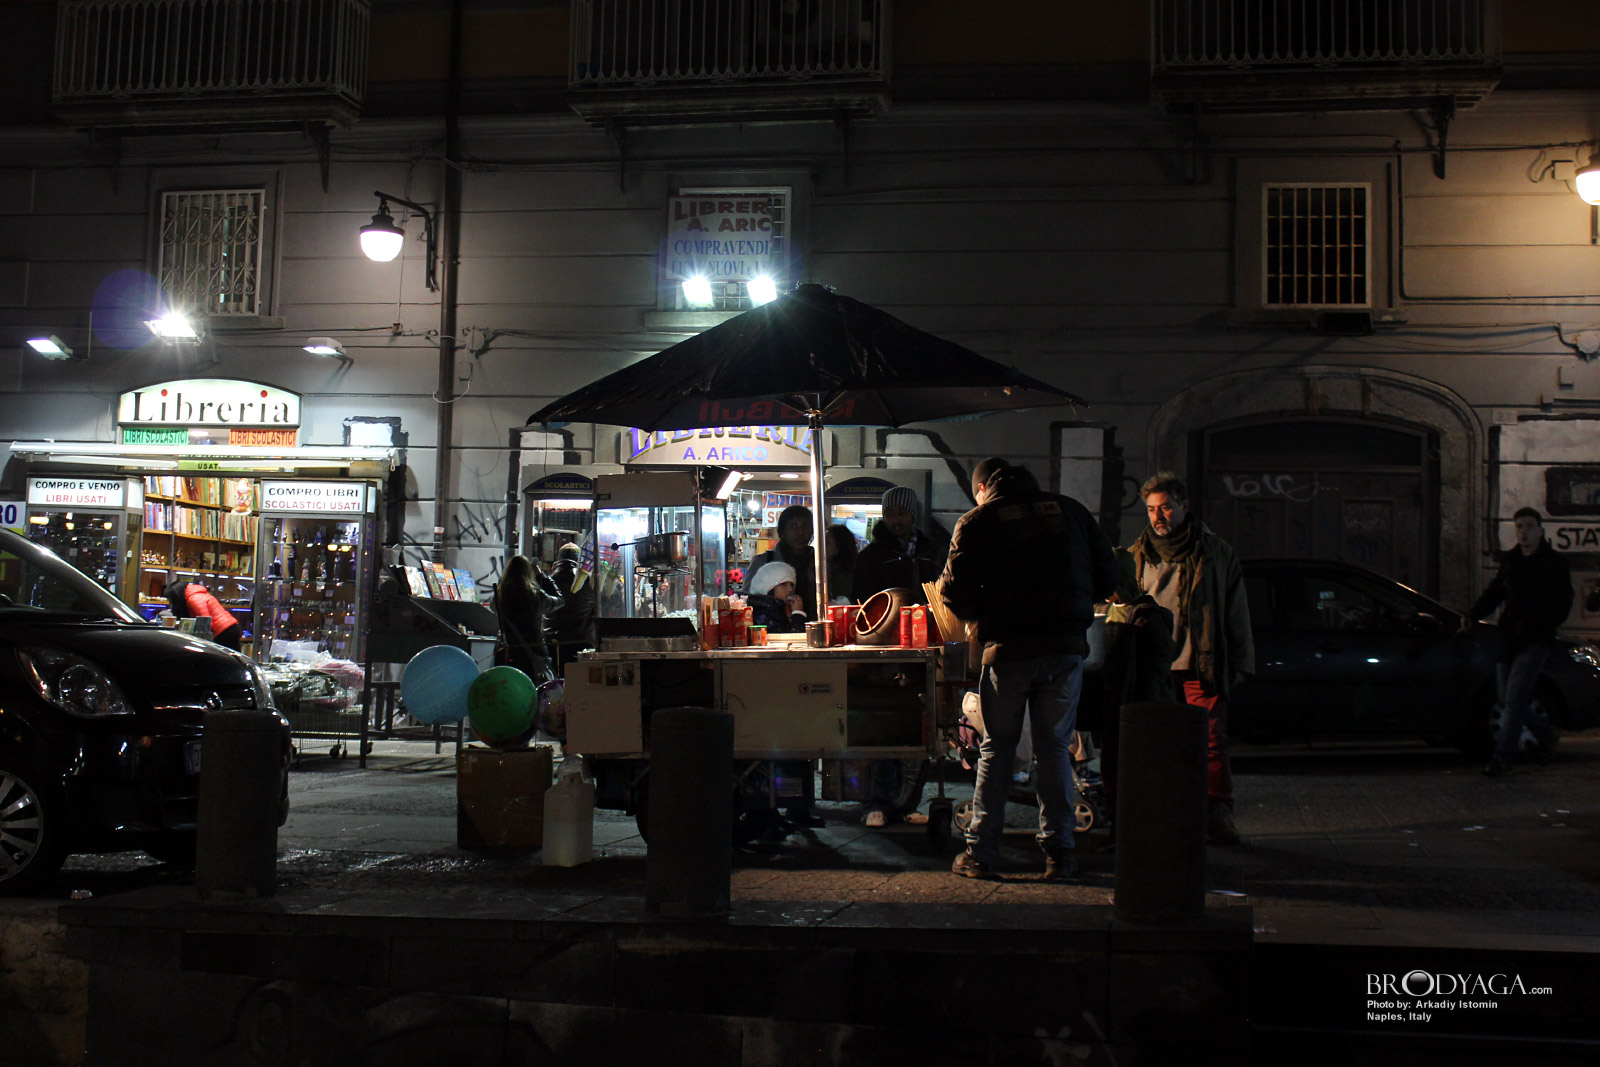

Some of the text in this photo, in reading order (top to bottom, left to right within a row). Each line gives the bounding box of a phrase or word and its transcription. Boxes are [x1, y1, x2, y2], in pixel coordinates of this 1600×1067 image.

[674, 200, 769, 221] LIBRER
[687, 218, 709, 232] A.
[709, 260, 745, 276] NUOVI
[131, 388, 290, 424] Libreria
[124, 428, 188, 445] LIBRI SCOLASTICI
[230, 429, 296, 446] LIBRI SCOLASTICI
[682, 443, 769, 461] A. ARICÒ
[35, 481, 120, 491] COMPRO E VENDO
[268, 487, 359, 498] COMPRO LIBRI
[45, 494, 107, 504] LIBRI USATI
[264, 500, 361, 511] SCOLASTICI USATI
